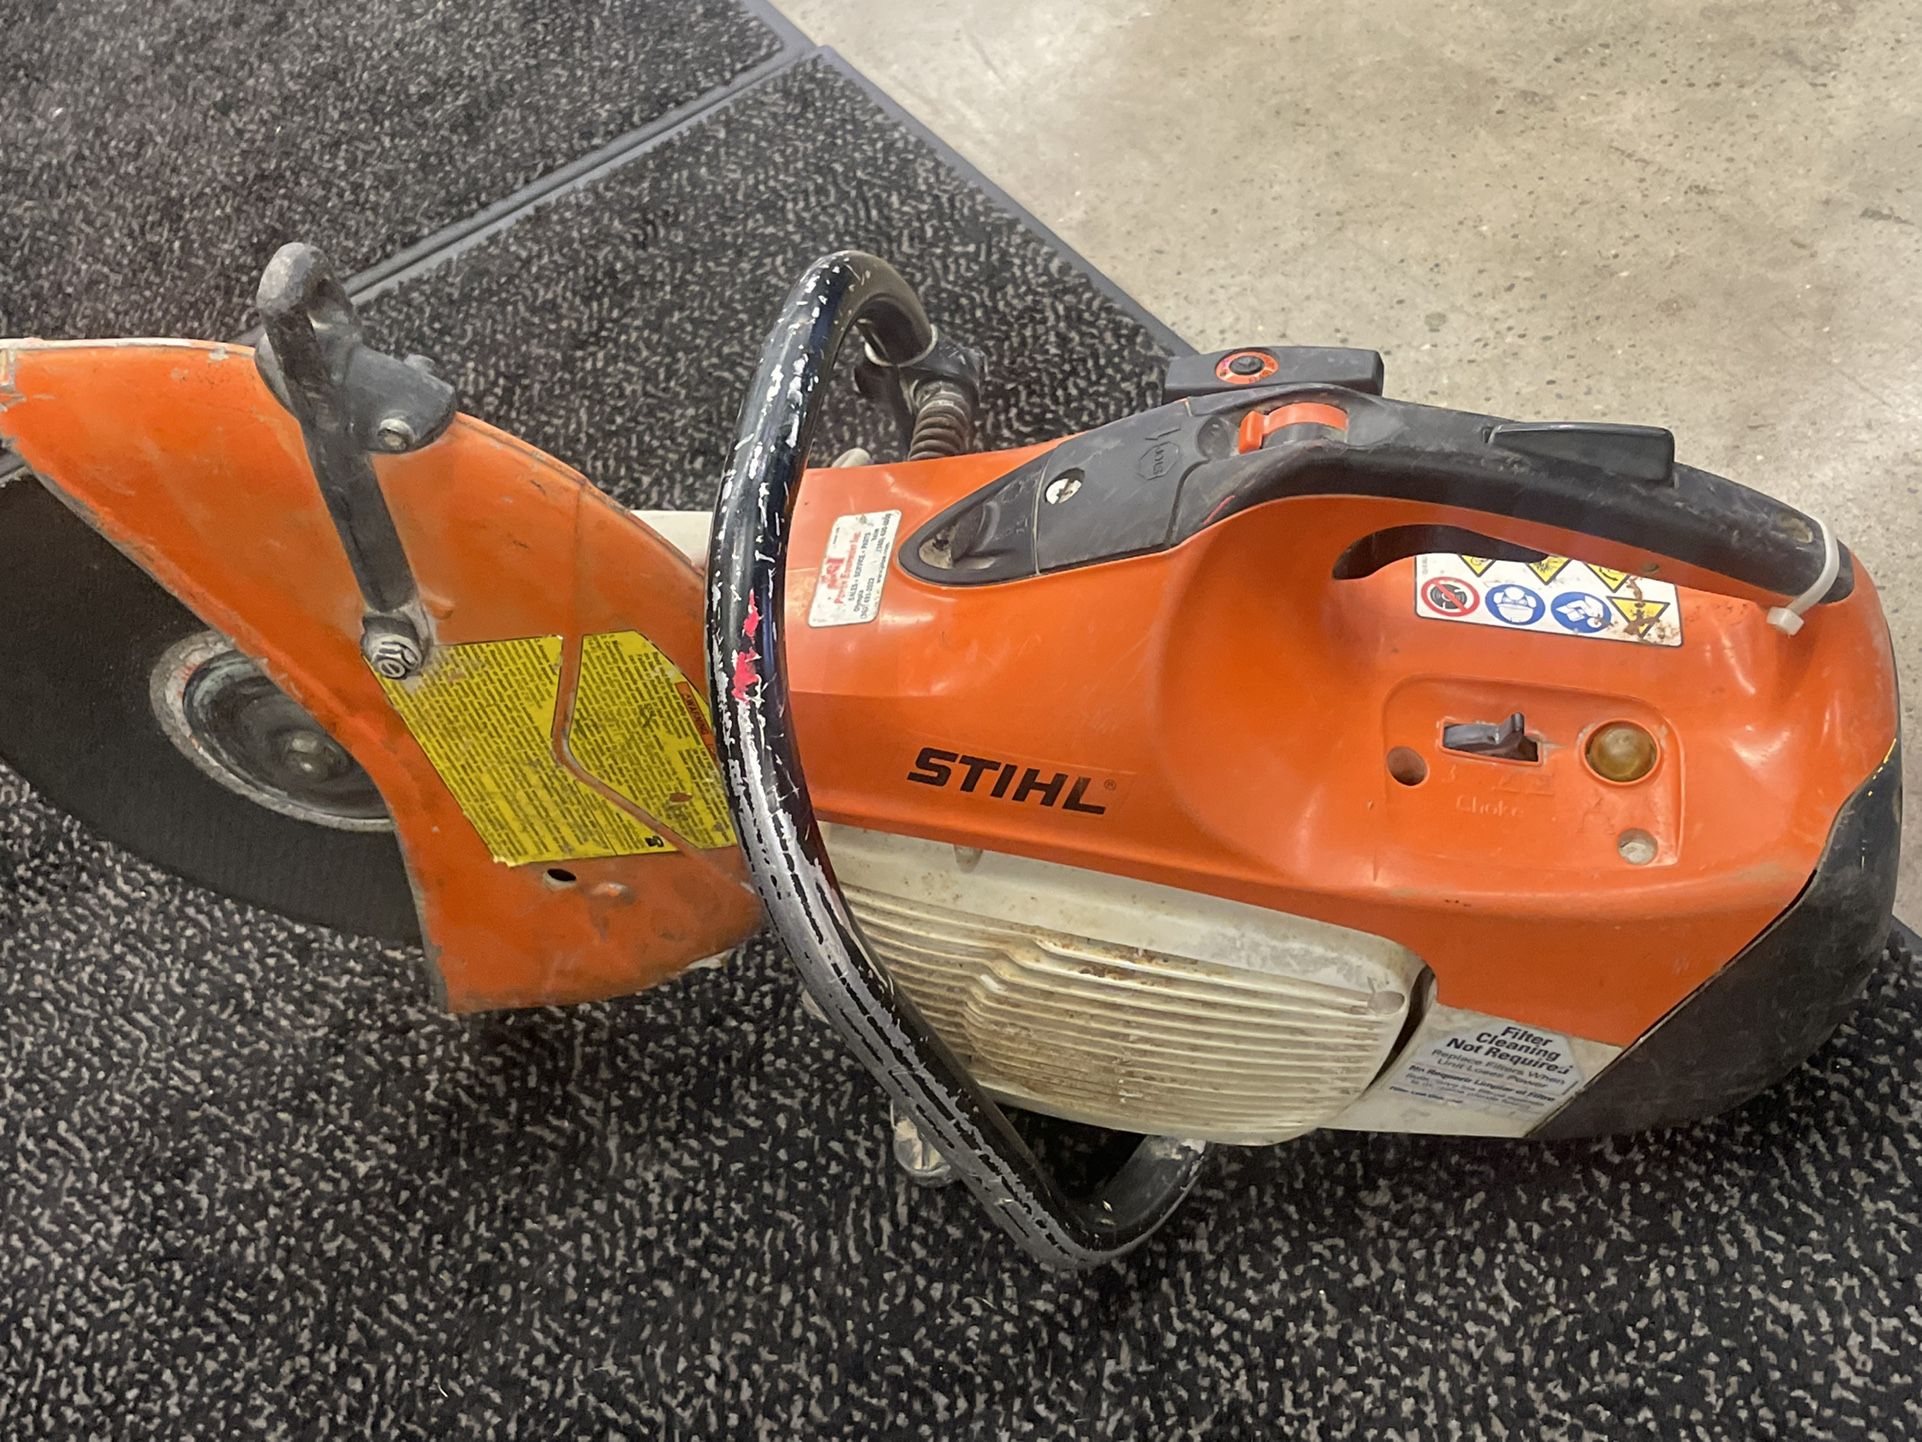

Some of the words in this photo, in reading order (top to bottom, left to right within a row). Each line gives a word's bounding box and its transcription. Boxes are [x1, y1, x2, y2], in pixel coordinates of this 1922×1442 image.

[906, 747, 1106, 815] STIHL
[1446, 1038, 1483, 1054] Not
[1476, 1032, 1561, 1062] Cleaning
[1501, 1026, 1553, 1046] Filter
